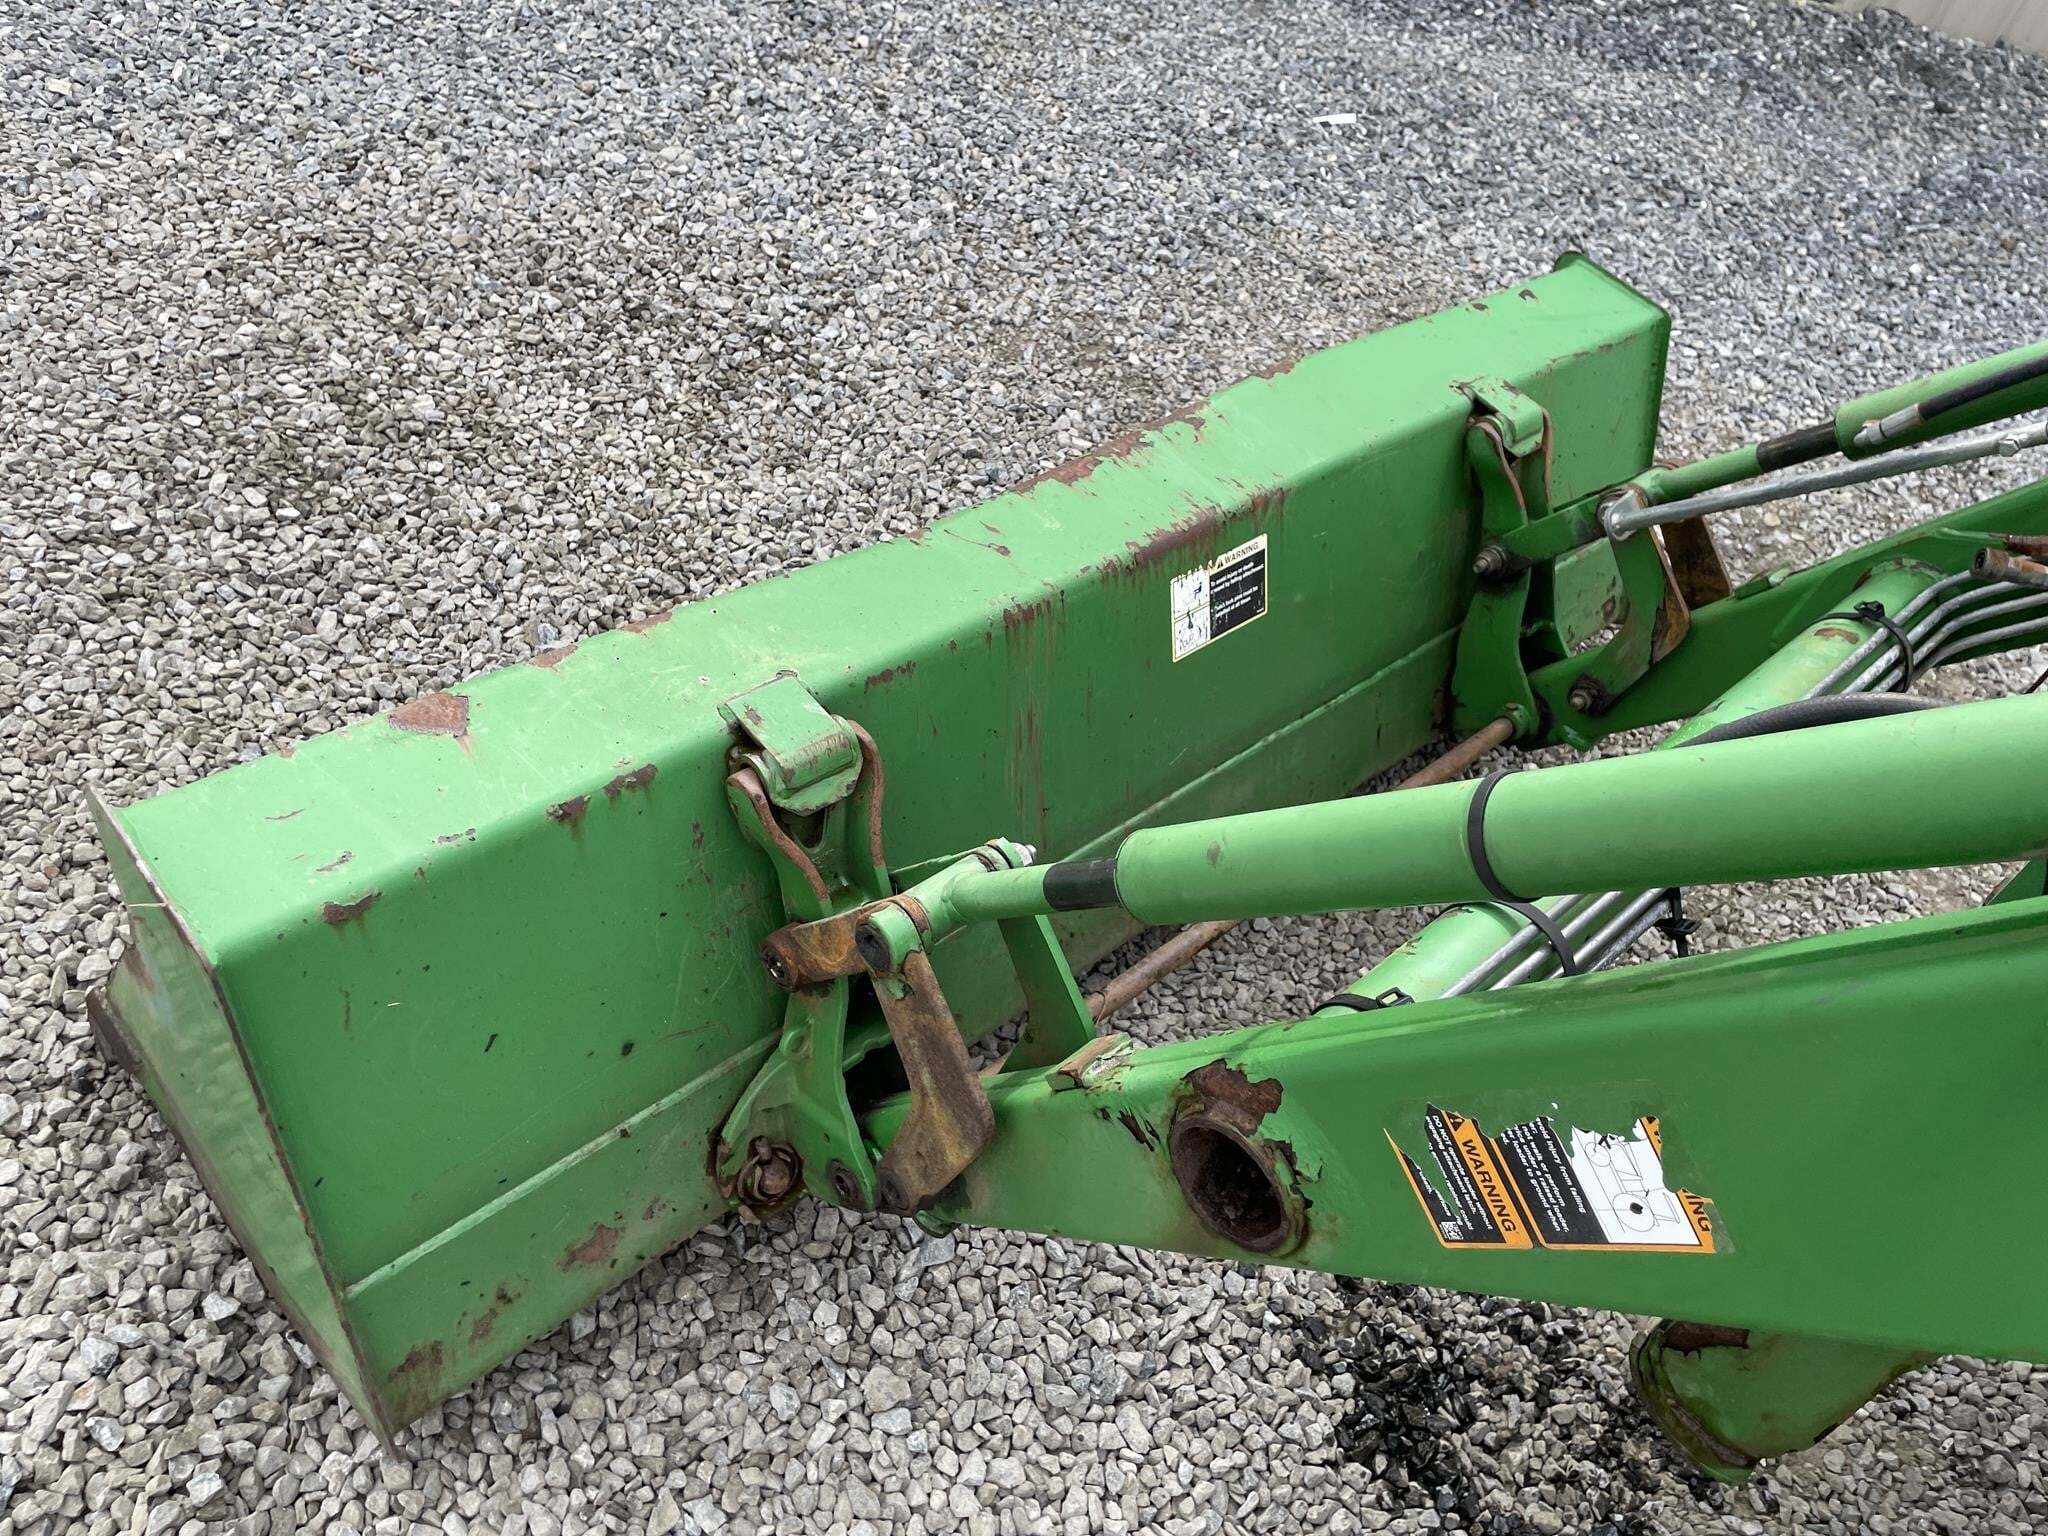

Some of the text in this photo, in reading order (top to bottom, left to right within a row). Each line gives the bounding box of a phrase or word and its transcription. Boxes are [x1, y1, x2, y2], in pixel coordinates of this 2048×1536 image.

[1224, 541, 1259, 565] WARNING
[1425, 1115, 1446, 1150] engaging
[1442, 1150, 1467, 1193] attachment
[1464, 1193, 1477, 1214] latch.
[1432, 1115, 1494, 1230] DO NOT operate loader without
[1461, 1139, 1516, 1232] WARNING
[1512, 1139, 1529, 1167] loader
[1526, 1168, 1534, 1178] to
[1530, 1178, 1551, 1209] ground
[1547, 1209, 1561, 1232] when
[1521, 1126, 1566, 1207] not walk or perform
[1523, 1144, 1539, 1170] under
[1539, 1177, 1557, 1204] raised
[1553, 1204, 1570, 1233] loader.
[1546, 1140, 1562, 1165] injury
[1559, 1165, 1573, 1186] from
[1569, 1187, 1586, 1214] falling
[1460, 1209, 1474, 1230] could
